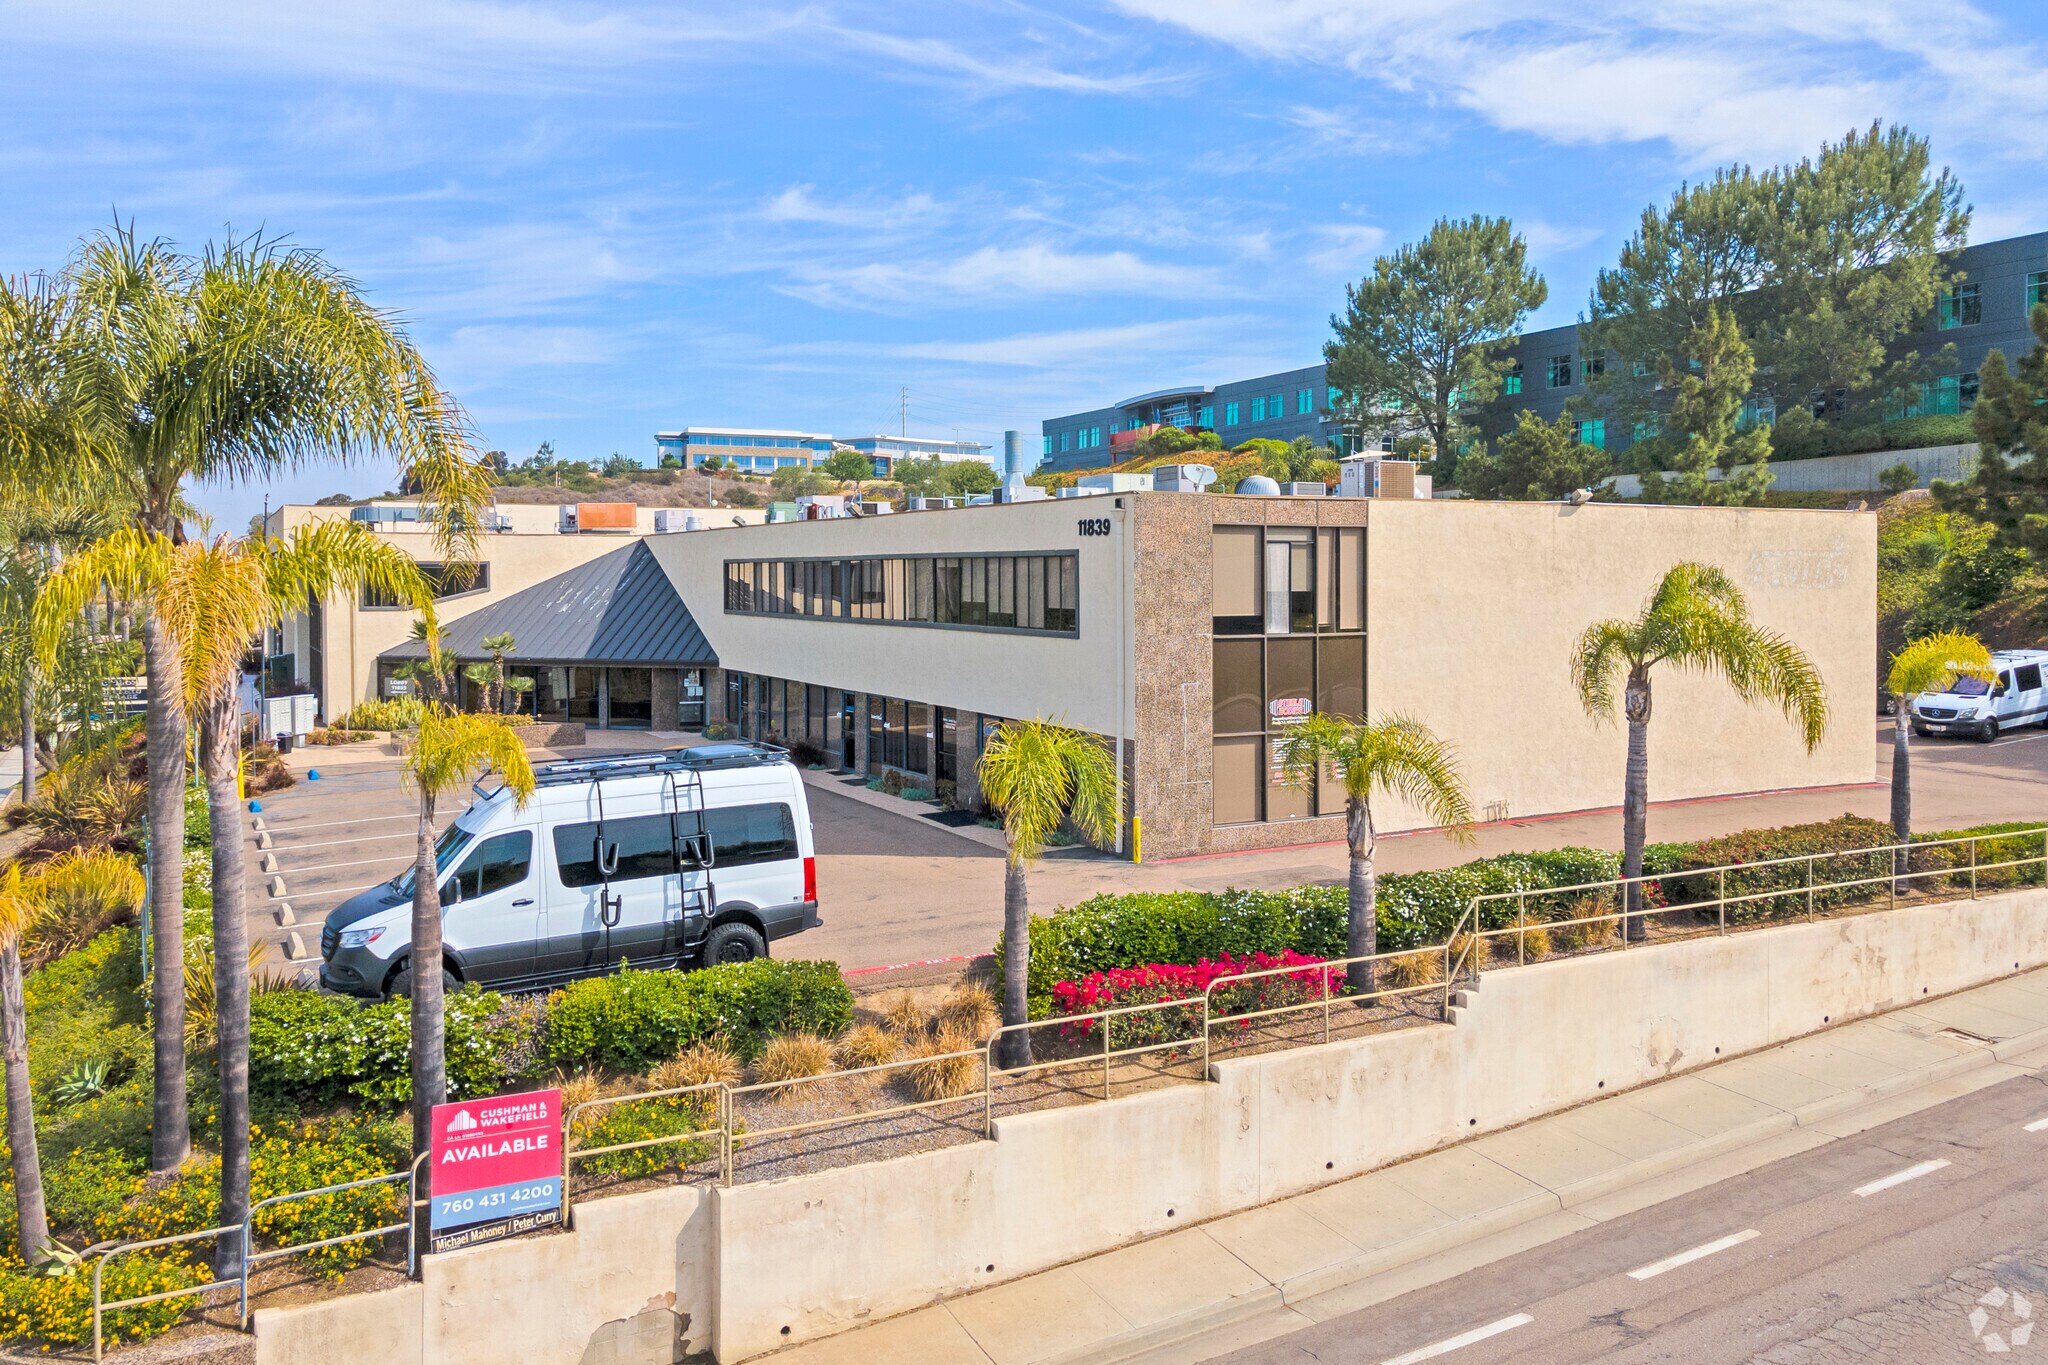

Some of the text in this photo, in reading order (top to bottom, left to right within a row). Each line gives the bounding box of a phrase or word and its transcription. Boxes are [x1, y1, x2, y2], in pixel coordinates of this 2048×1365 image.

[1077, 518, 1111, 536] 11839
[480, 1101, 547, 1118] CUSHMAN &
[480, 1110, 548, 1127] WAKEFIELD
[441, 1135, 548, 1164] AVAILABLE
[442, 1197, 474, 1215] 760
[479, 1192, 506, 1208] 431
[510, 1184, 553, 1202] 4200
[435, 1234, 469, 1251] Michael
[470, 1225, 506, 1242] Mahoney
[507, 1221, 512, 1232] /
[513, 1217, 534, 1231] Peter
[535, 1211, 557, 1224] Curry
